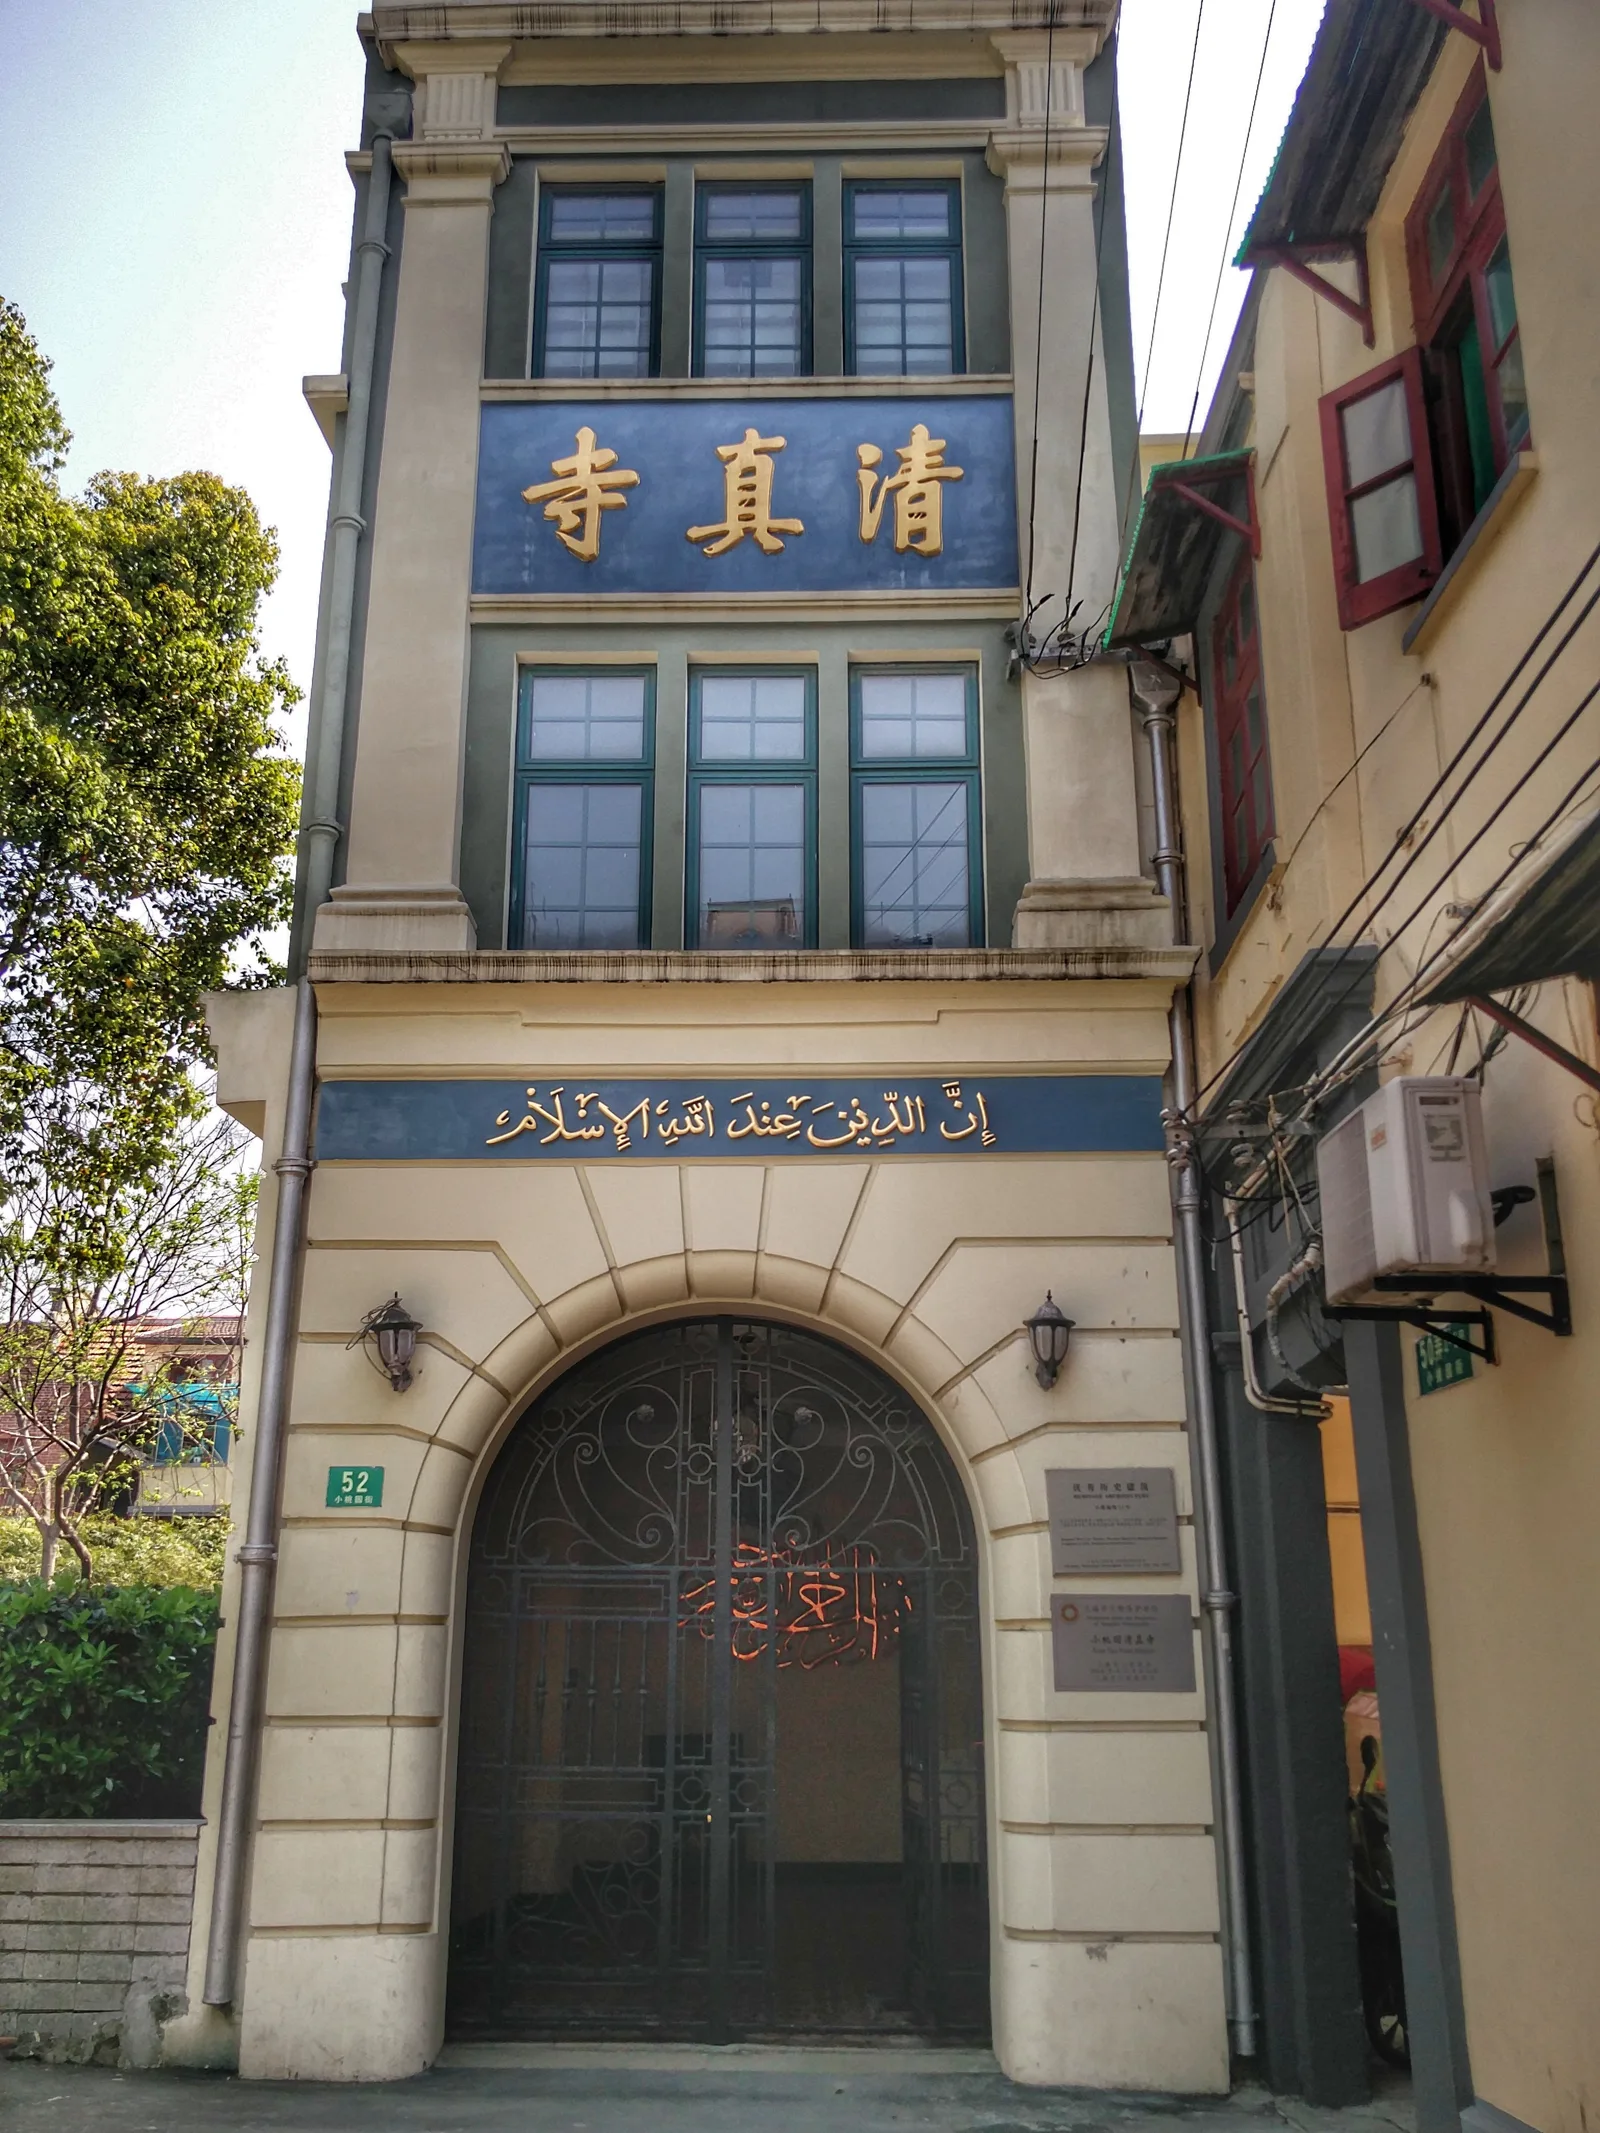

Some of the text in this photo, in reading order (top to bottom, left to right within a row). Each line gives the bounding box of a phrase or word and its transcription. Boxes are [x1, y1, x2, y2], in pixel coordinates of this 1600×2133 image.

[522, 424, 964, 562] 清真寺
[341, 1470, 369, 1493] 52
